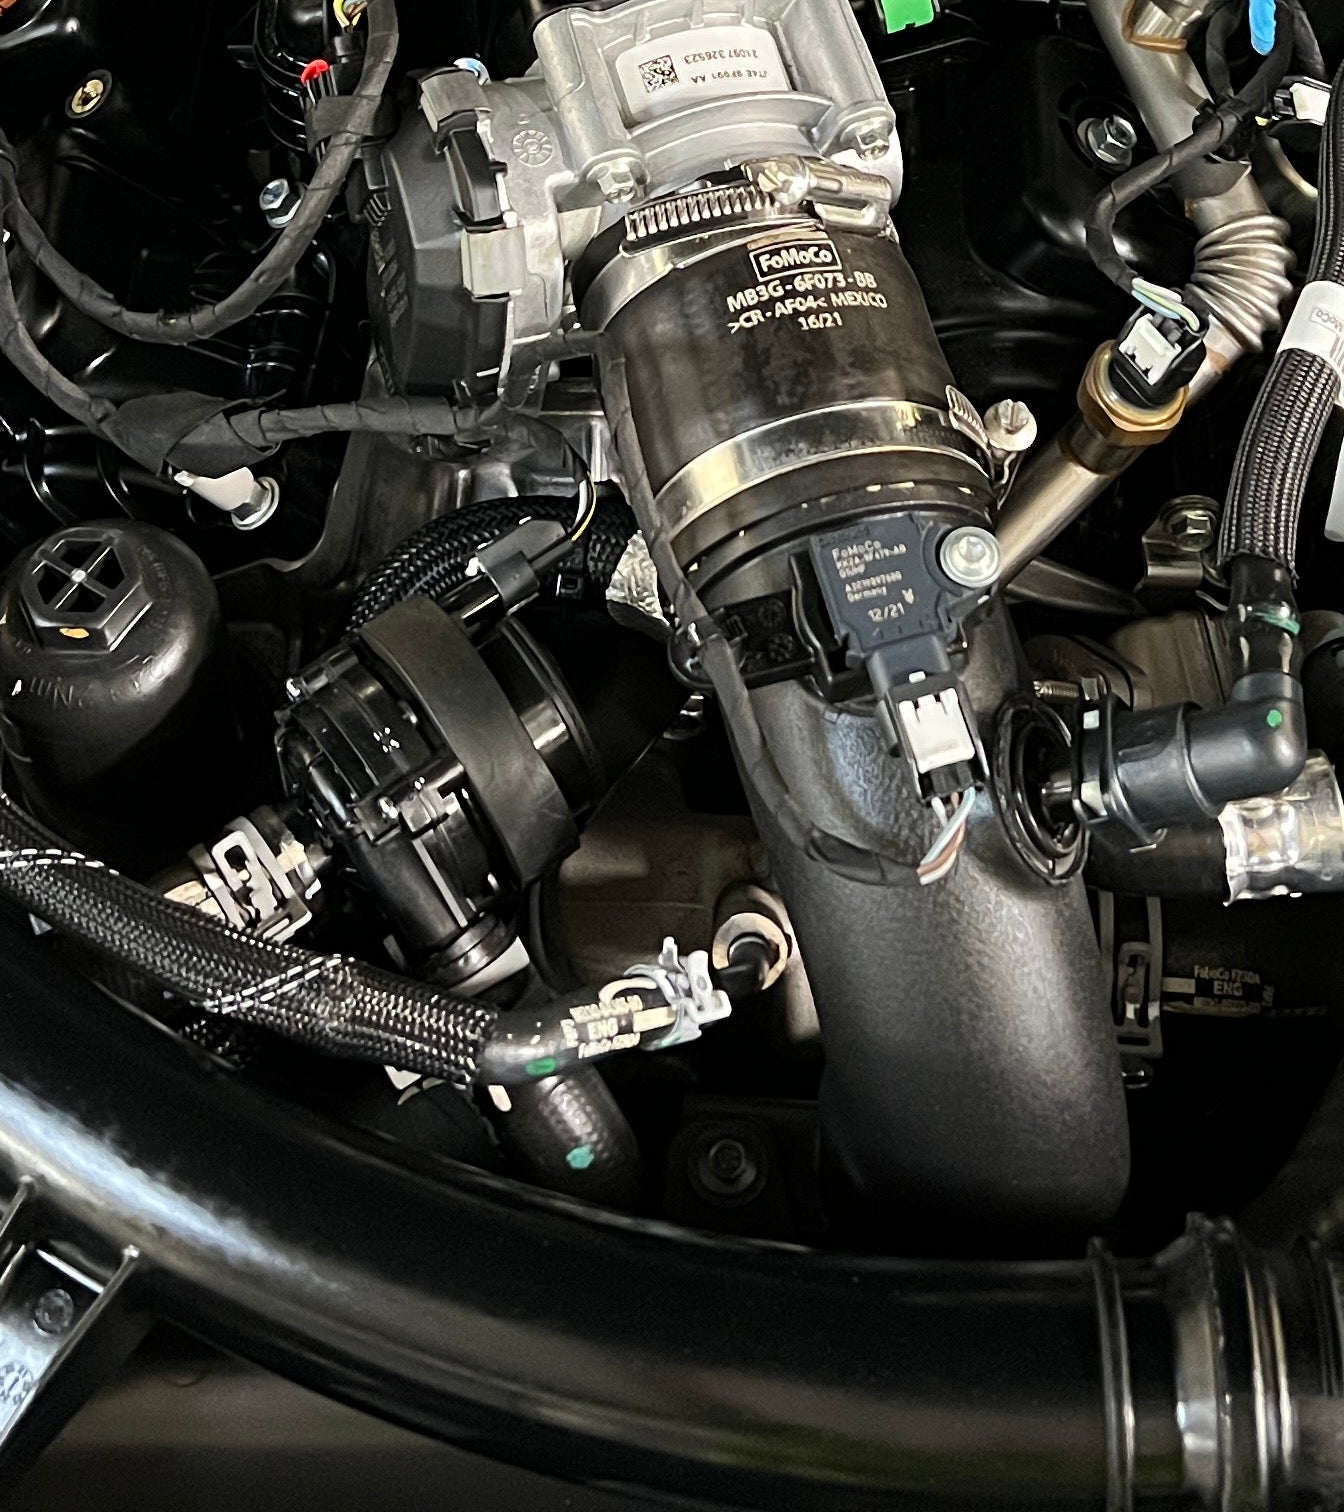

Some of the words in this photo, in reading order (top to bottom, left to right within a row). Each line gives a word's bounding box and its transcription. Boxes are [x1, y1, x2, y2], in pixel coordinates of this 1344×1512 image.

[759, 245, 833, 273] FoMoCo
[830, 292, 888, 309] MEXICO
[798, 311, 843, 331] 16/21
[867, 602, 905, 622] 12/21
[1213, 980, 1244, 996] ENG
[586, 1019, 619, 1039] ENG
